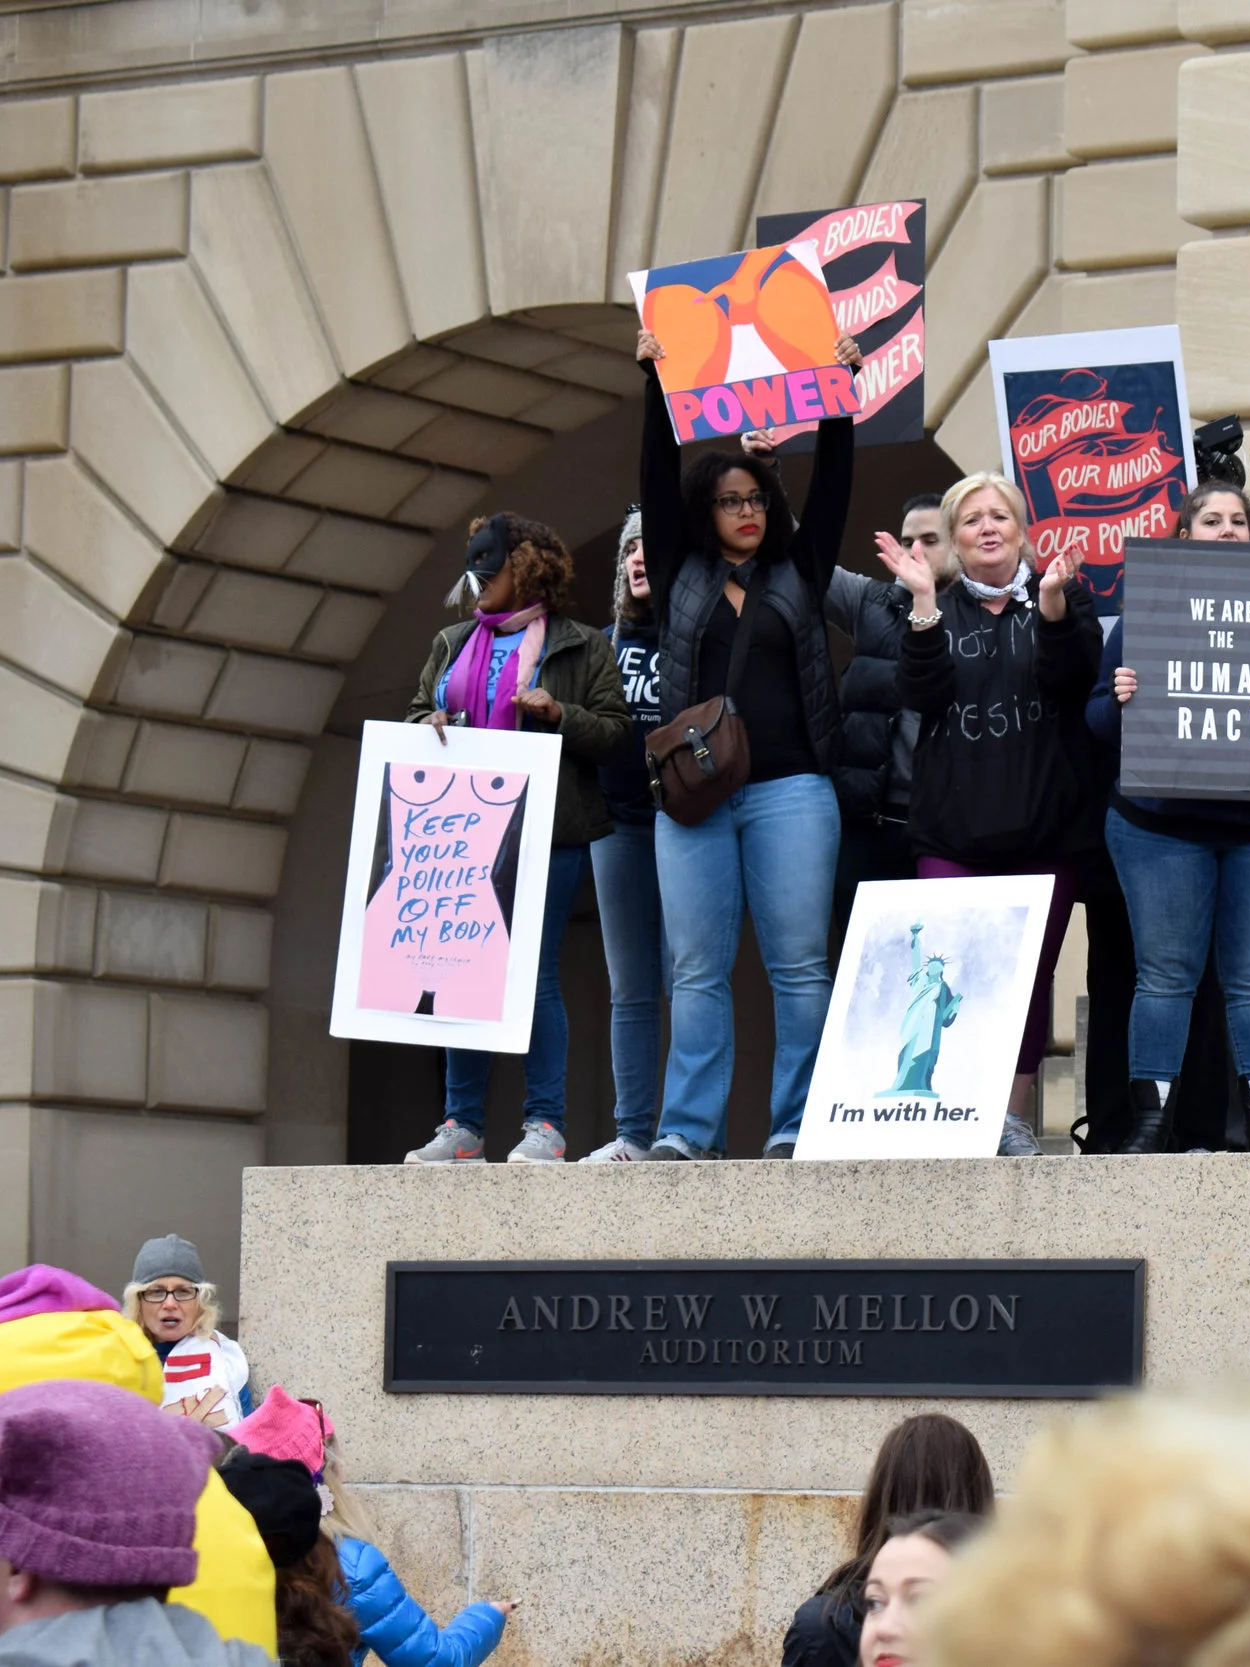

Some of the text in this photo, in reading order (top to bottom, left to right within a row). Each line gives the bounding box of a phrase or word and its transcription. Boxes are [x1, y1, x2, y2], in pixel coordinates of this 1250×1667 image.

[823, 203, 903, 257] BODIES
[853, 333, 924, 409] OWER
[667, 366, 861, 442] POWER
[1017, 402, 1119, 457] OUR BODIES
[1057, 447, 1163, 492] OUR MINDS
[1036, 503, 1168, 558] OUR POWER
[1190, 598, 1215, 622] WE
[1208, 630, 1234, 649] THE
[402, 807, 481, 841] KEEP
[401, 840, 470, 871] YOUR
[396, 865, 490, 902] POLICIES
[397, 893, 477, 924] OFF
[390, 920, 496, 952] MY BODY
[829, 1102, 980, 1123] I'm with her.
[496, 1294, 1021, 1332] ANDREW W. MELLON
[639, 1338, 864, 1365] AUDITORIUM
